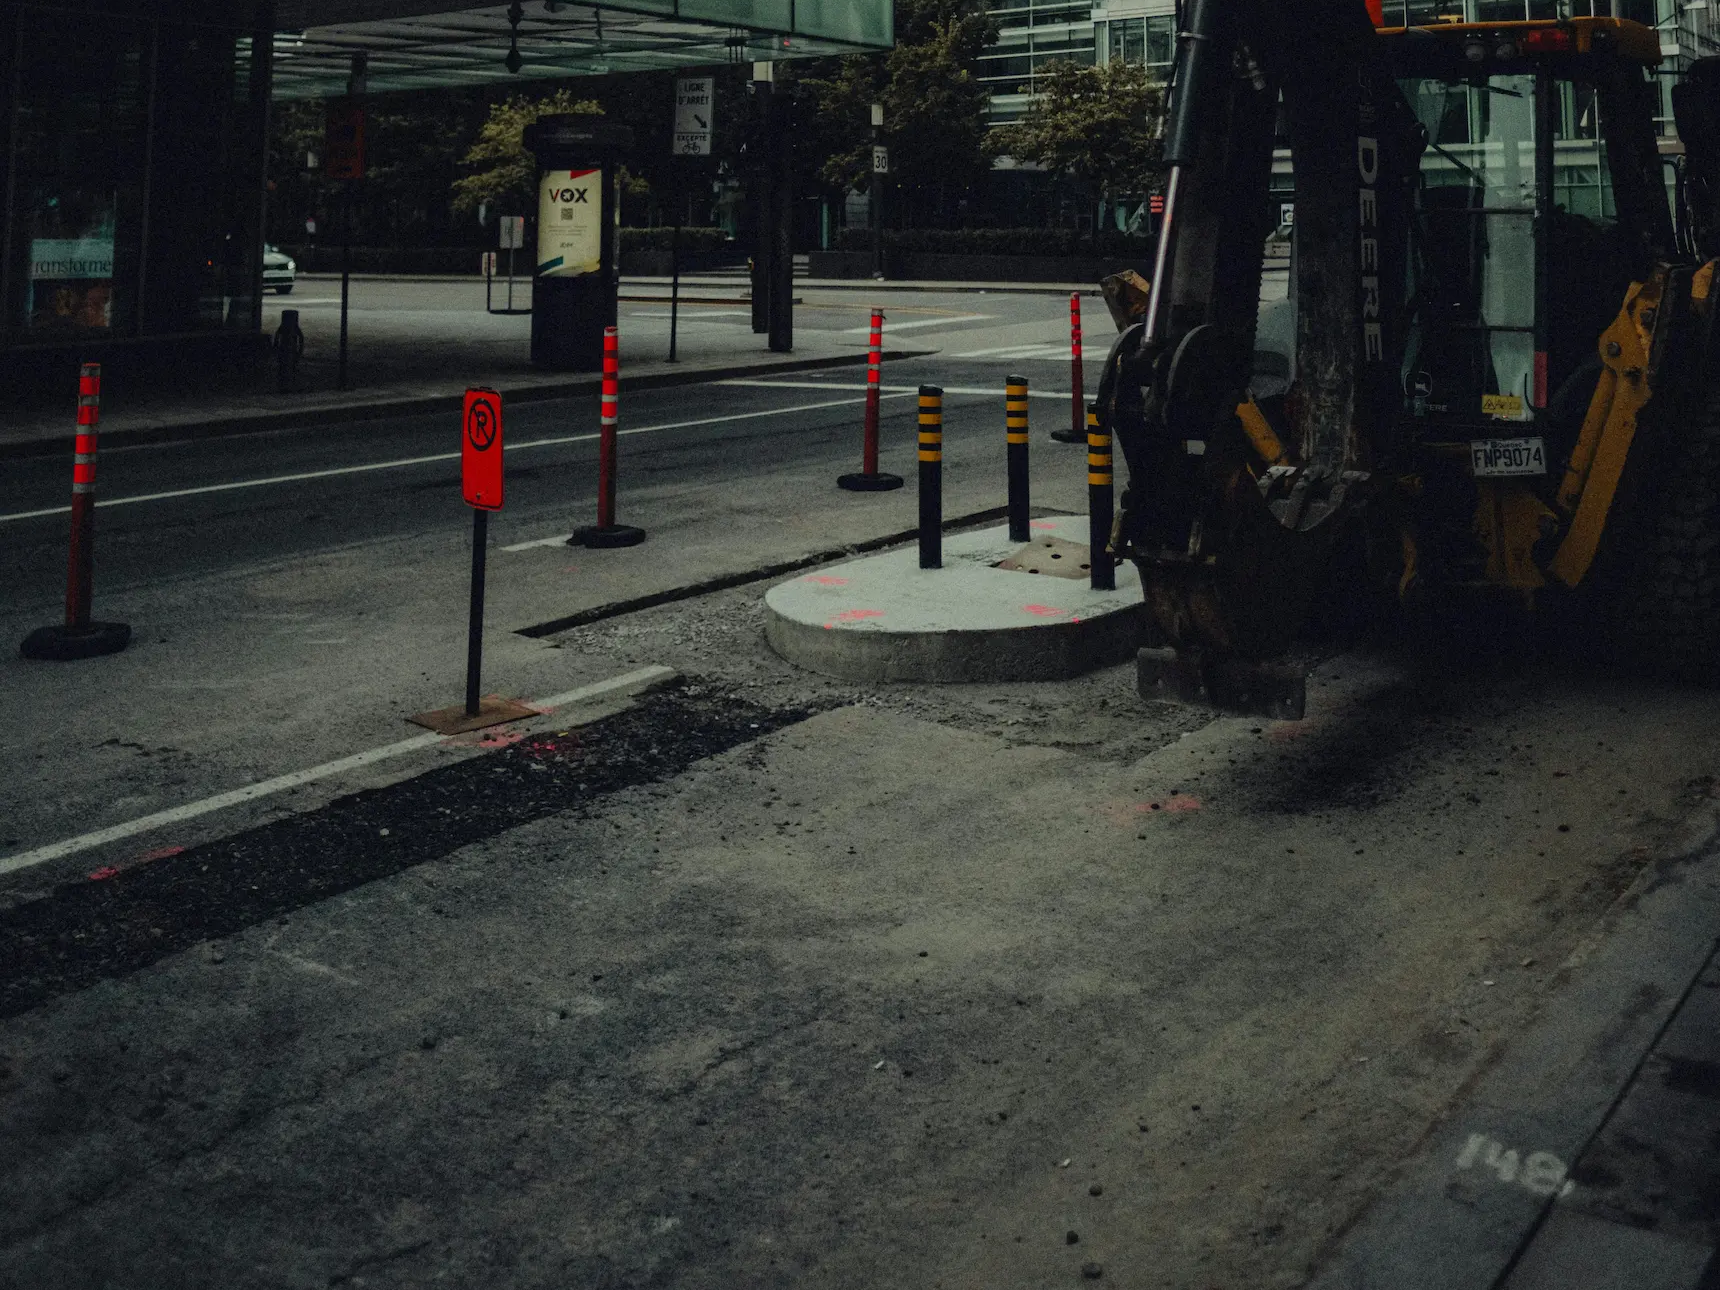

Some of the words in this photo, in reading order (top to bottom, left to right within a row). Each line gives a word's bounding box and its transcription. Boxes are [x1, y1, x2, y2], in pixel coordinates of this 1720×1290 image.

[684, 82, 705, 92] LIGNE
[875, 155, 887, 169] 30
[549, 188, 588, 203] VOX
[1357, 136, 1383, 361] DEERE
[1473, 447, 1543, 468] FNP9074
